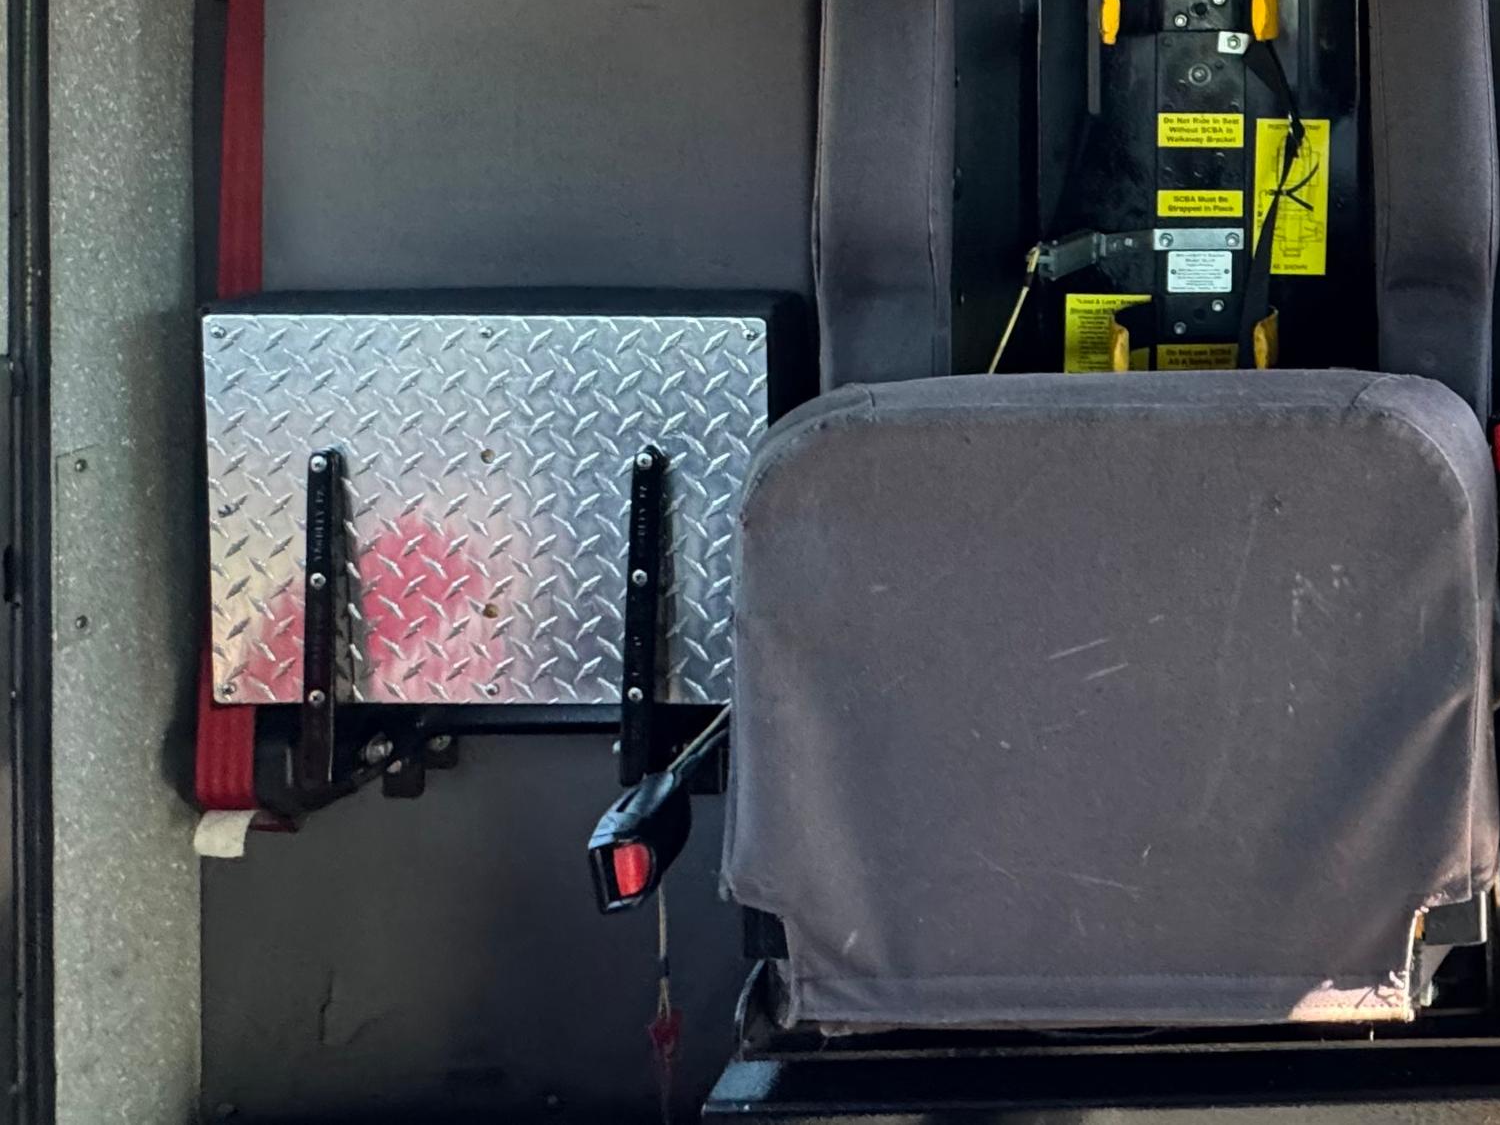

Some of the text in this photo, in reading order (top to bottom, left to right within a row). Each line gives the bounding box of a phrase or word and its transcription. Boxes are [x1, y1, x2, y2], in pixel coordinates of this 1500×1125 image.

[1193, 116, 1210, 124] Ride
[1222, 117, 1239, 125] Seat
[1166, 136, 1204, 145] Walkaway
[1168, 205, 1203, 214] Strapped
